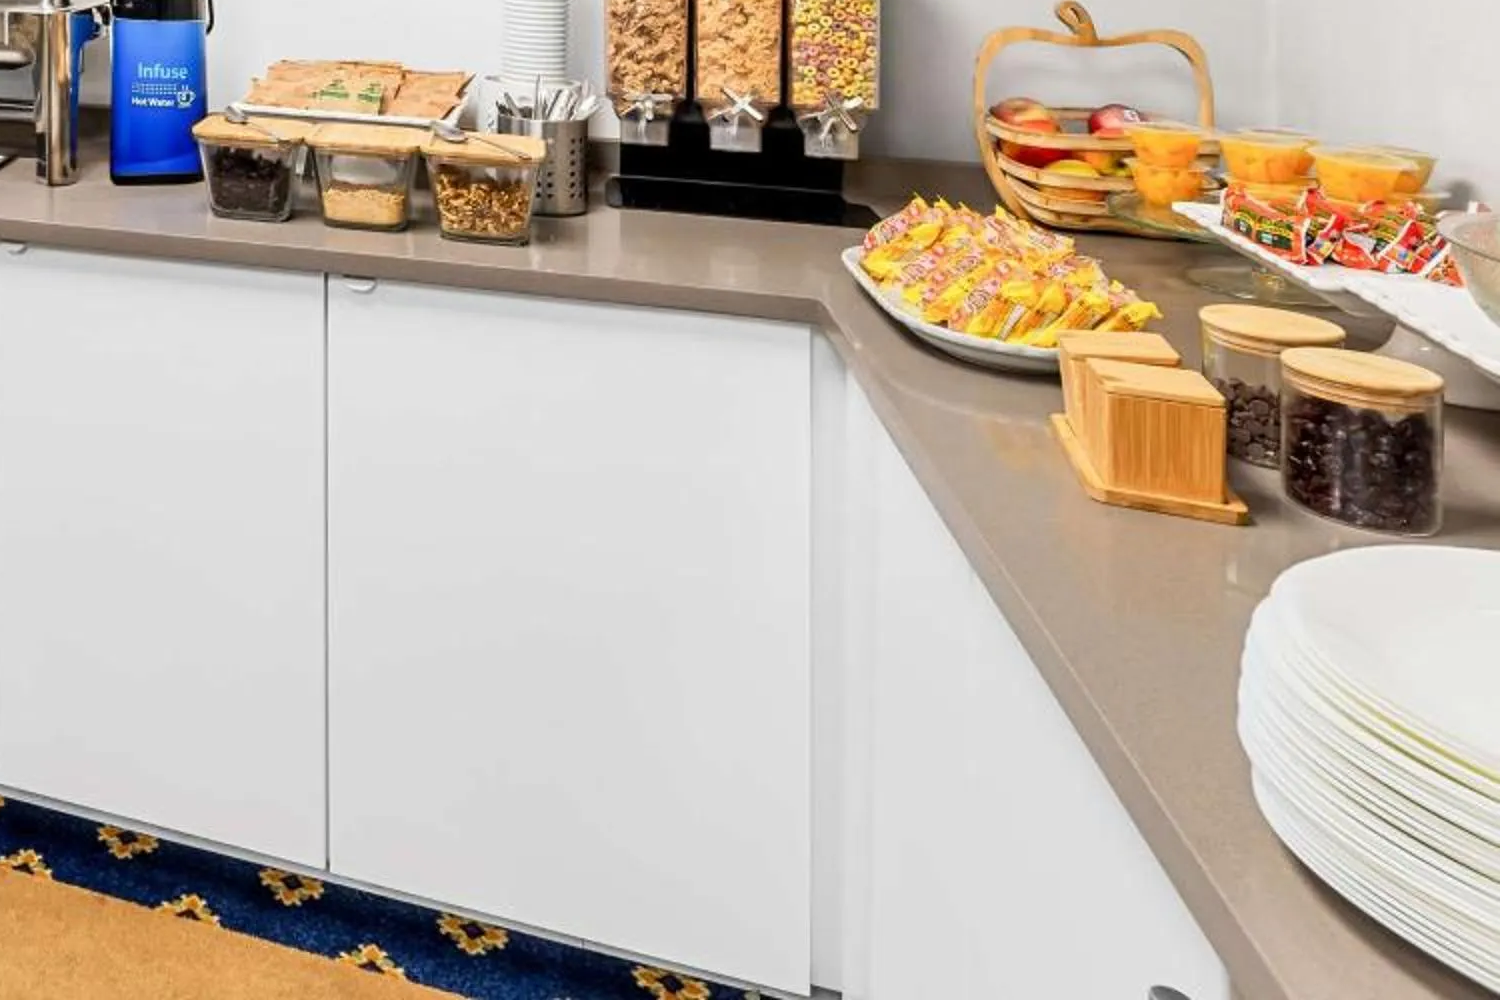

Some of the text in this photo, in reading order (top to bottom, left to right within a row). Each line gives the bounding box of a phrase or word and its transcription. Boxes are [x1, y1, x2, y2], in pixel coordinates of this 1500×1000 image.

[138, 62, 188, 79] Infuse
[132, 97, 175, 107] Hot Water
